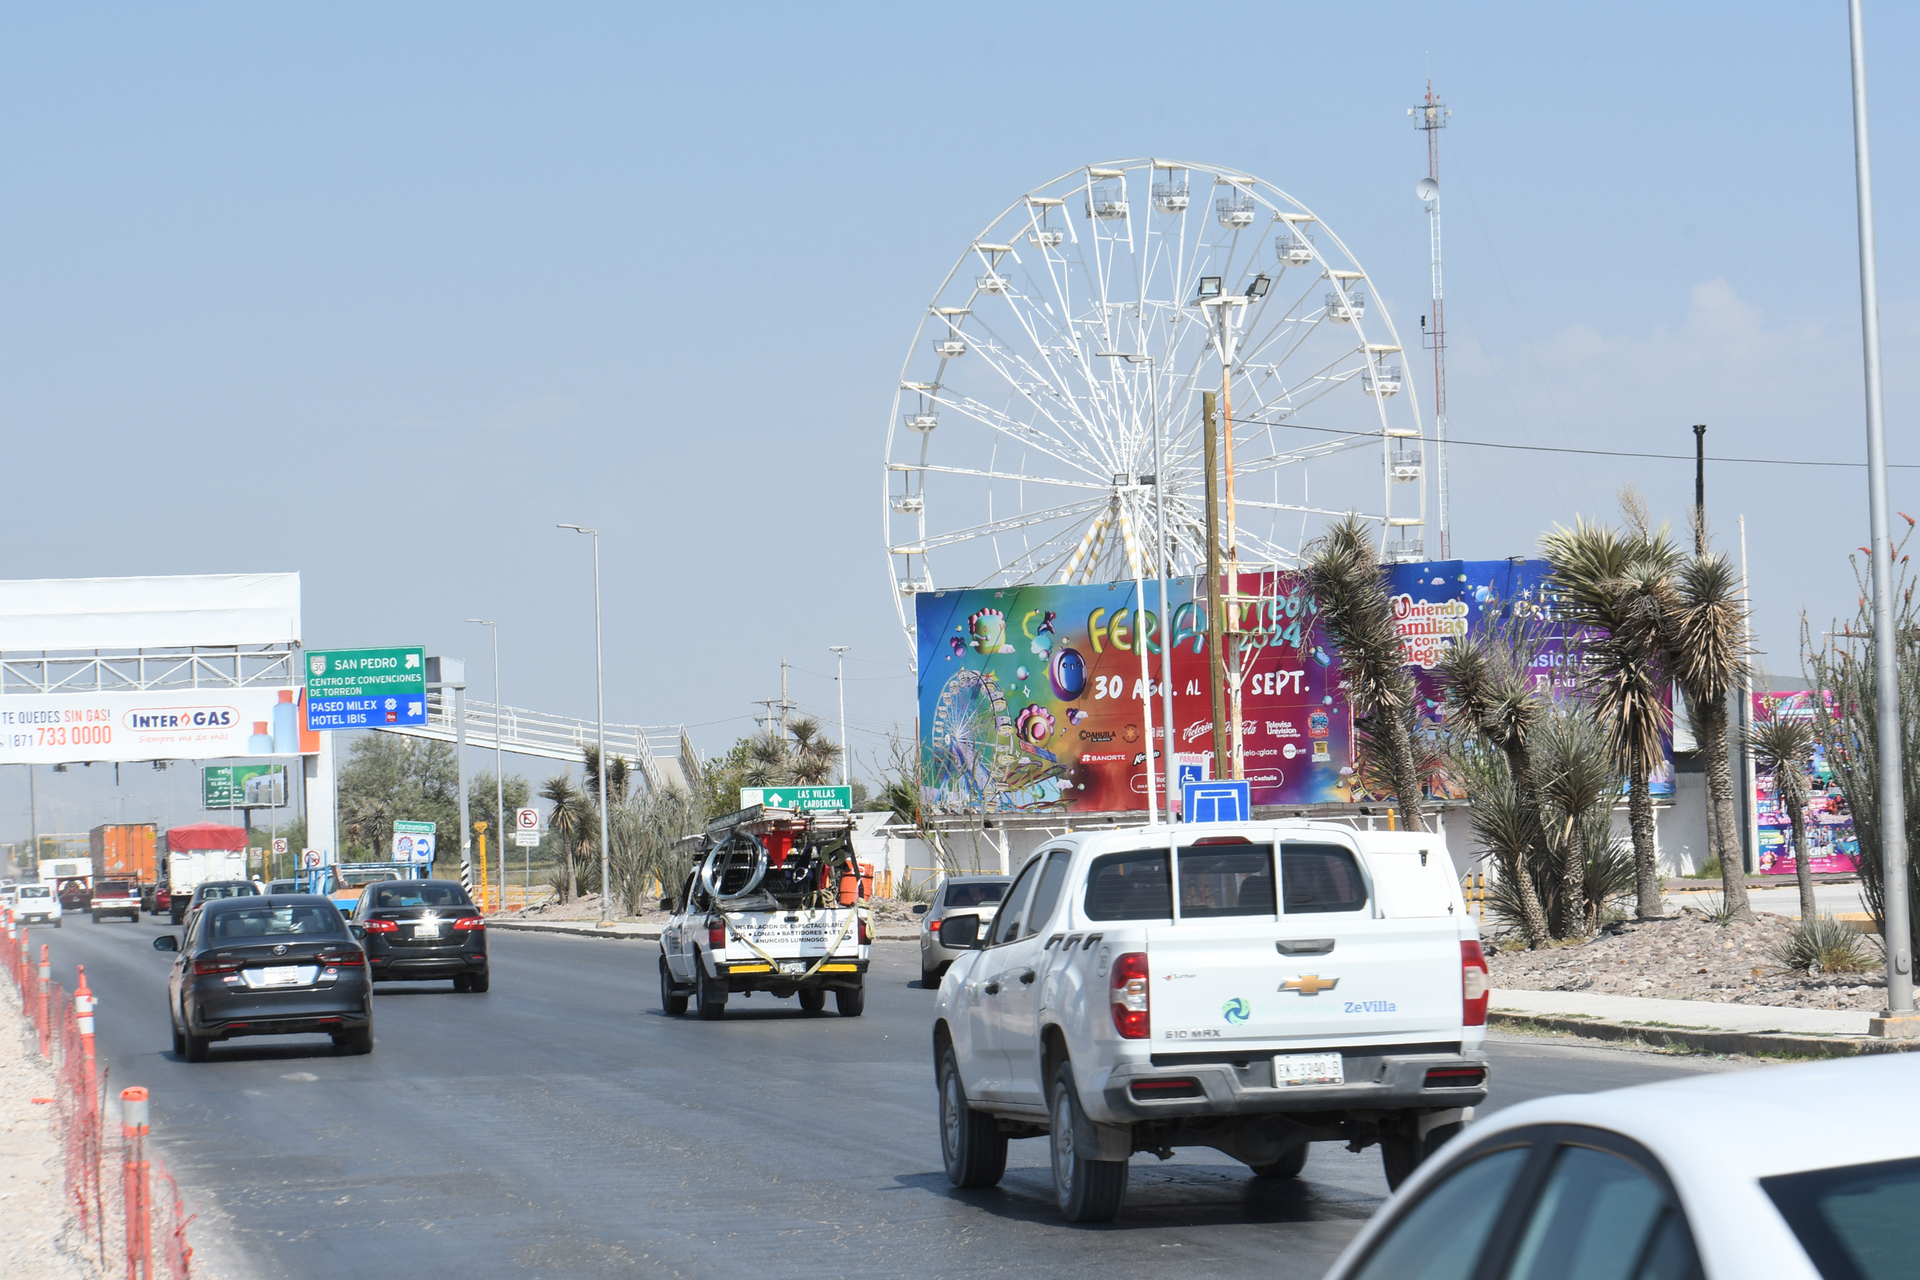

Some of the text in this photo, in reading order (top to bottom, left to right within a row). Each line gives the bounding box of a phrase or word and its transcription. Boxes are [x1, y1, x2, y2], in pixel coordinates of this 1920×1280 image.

[1394, 597, 1466, 620] Uniendo
[1396, 617, 1465, 636] amilias
[1415, 637, 1439, 648] con
[334, 659, 357, 670] SAN
[360, 658, 398, 669] PEDRO
[310, 673, 422, 687] CENTRO DE CONVENCIONES
[1094, 675, 1123, 700] 30
[1185, 678, 1202, 696] AL
[1251, 669, 1310, 695] SEPT.
[310, 687, 362, 697] DE TORREON
[311, 700, 378, 712] PASEO MILEX
[2, 708, 111, 724] TE QUEDES SIN GAS!
[193, 711, 231, 726] GAS
[311, 713, 367, 726] HOTEL IBIS
[13, 725, 112, 747] 871 733 0000
[139, 735, 175, 745] Siempre
[195, 733, 207, 741] da
[1078, 729, 1117, 741] COAHUILA
[1091, 754, 1126, 762] BANORTE
[1179, 755, 1204, 763] PARADA
[797, 789, 835, 799] LAS VILLAS
[788, 799, 845, 808] DEL CARDENCHAL
[790, 921, 846, 930] ESPECTACULARE
[1343, 1000, 1397, 1014] ZeVilla
